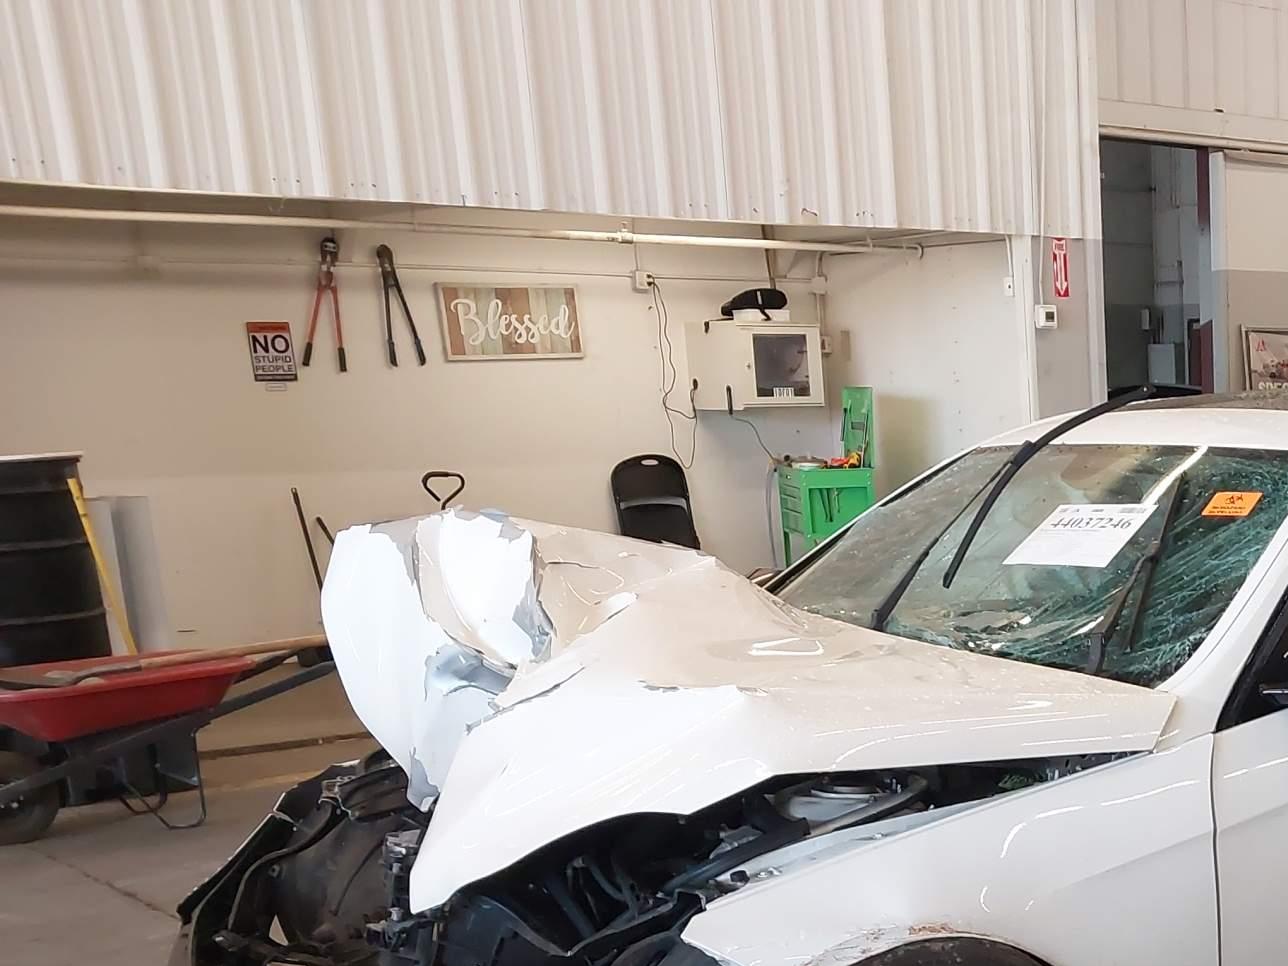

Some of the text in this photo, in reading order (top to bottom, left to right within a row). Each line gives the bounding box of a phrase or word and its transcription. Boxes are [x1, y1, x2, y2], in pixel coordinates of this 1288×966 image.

[450, 298, 576, 345] Blessed
[251, 334, 290, 354] NO
[254, 355, 292, 363] STUPID
[255, 364, 294, 373] PEOPLE
[1051, 517, 1135, 529] 44037246
